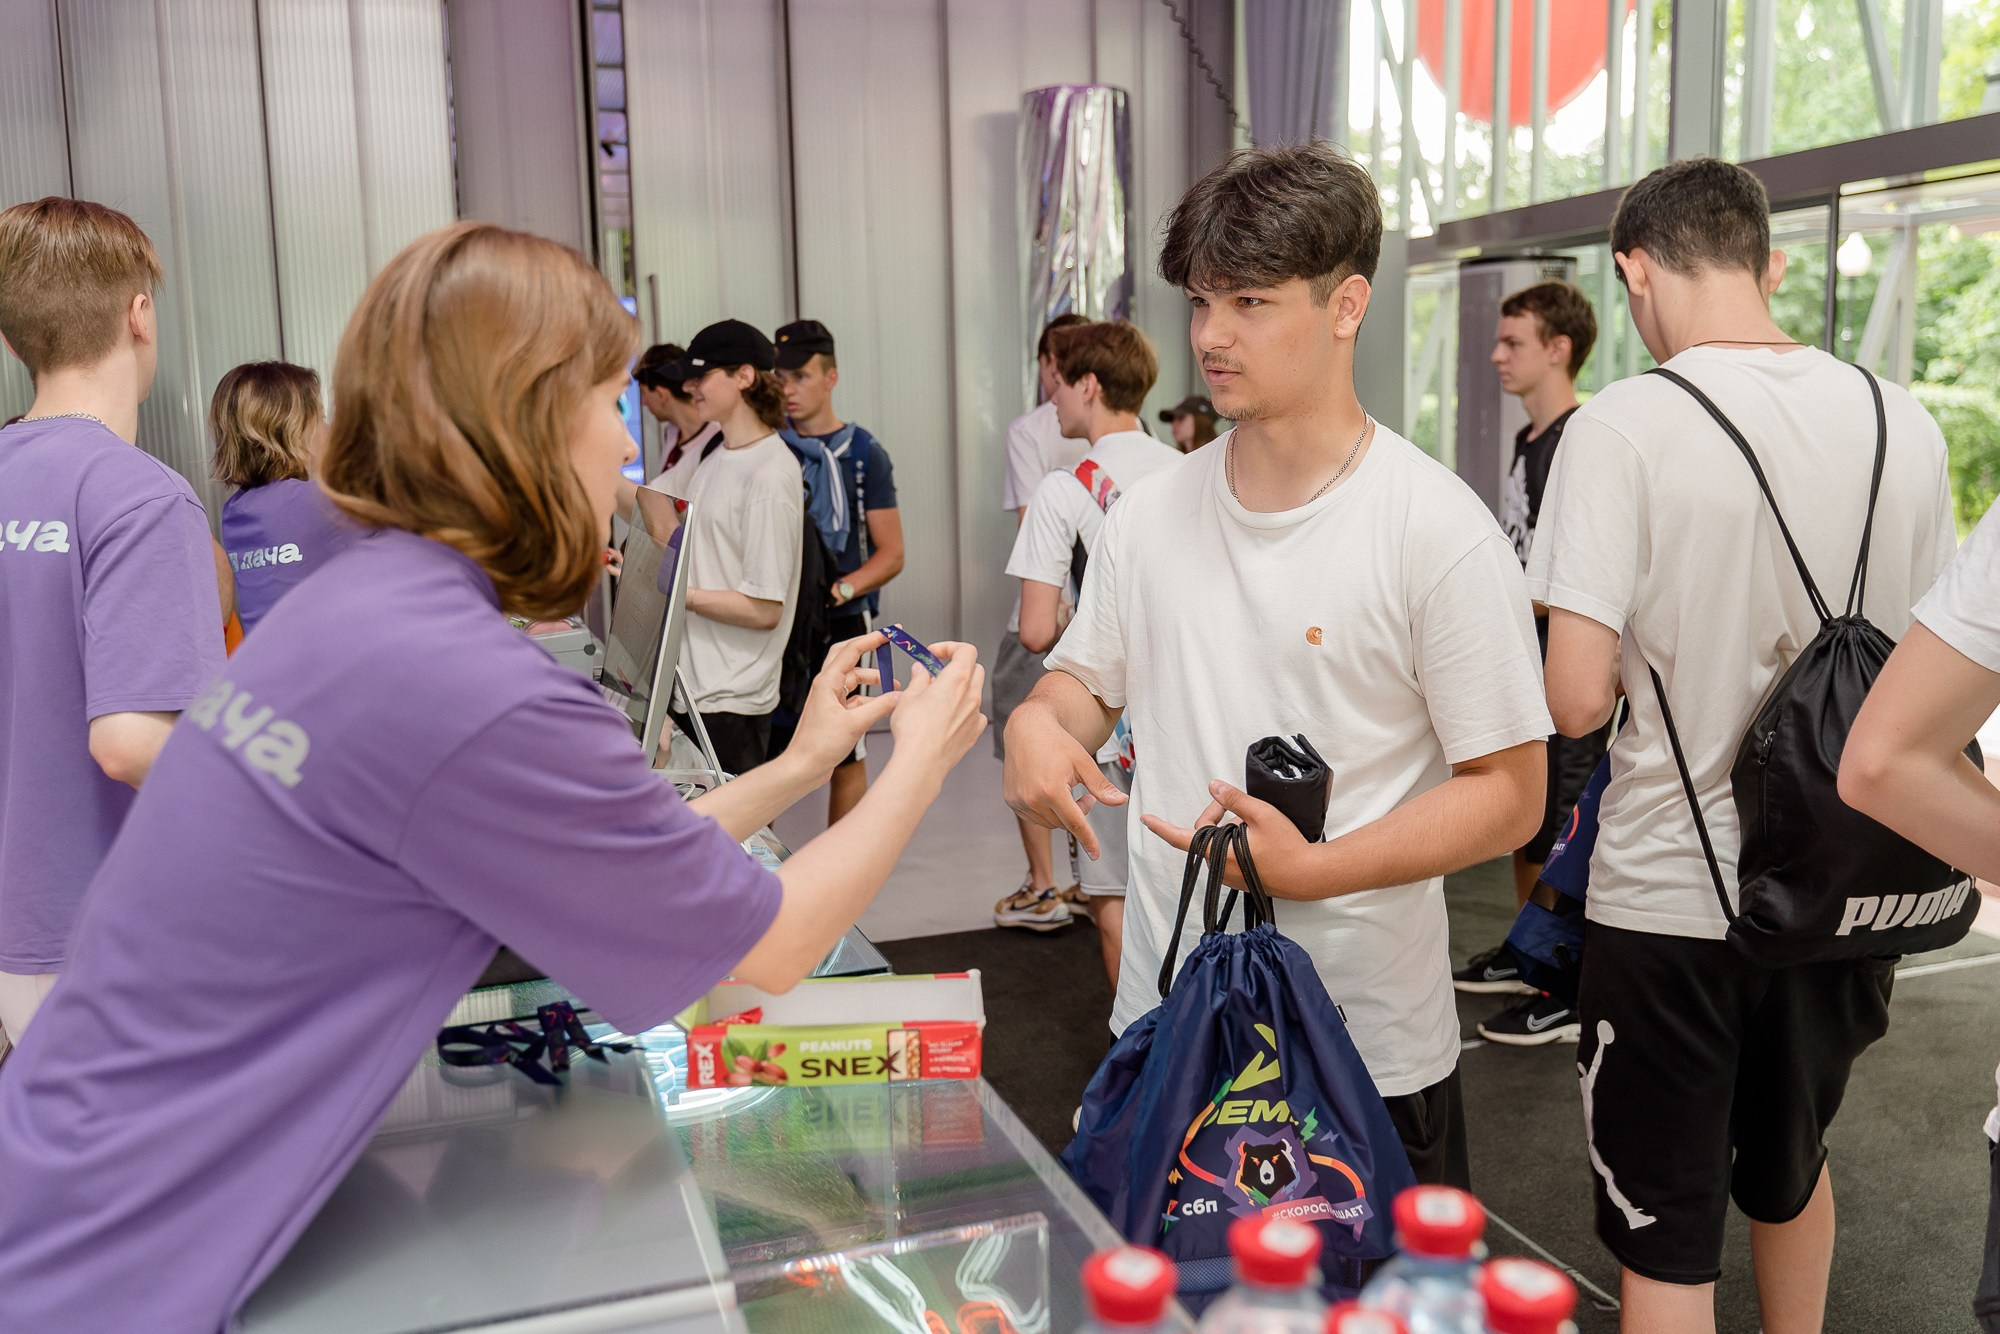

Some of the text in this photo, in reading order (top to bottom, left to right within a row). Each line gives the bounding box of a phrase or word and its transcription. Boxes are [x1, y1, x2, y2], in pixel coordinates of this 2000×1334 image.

[0, 520, 70, 553] ча
[1835, 878, 1971, 936] PUMA
[799, 1039, 873, 1054] PEANUTS
[698, 1042, 716, 1085] REX
[800, 1051, 902, 1079] SNEX
